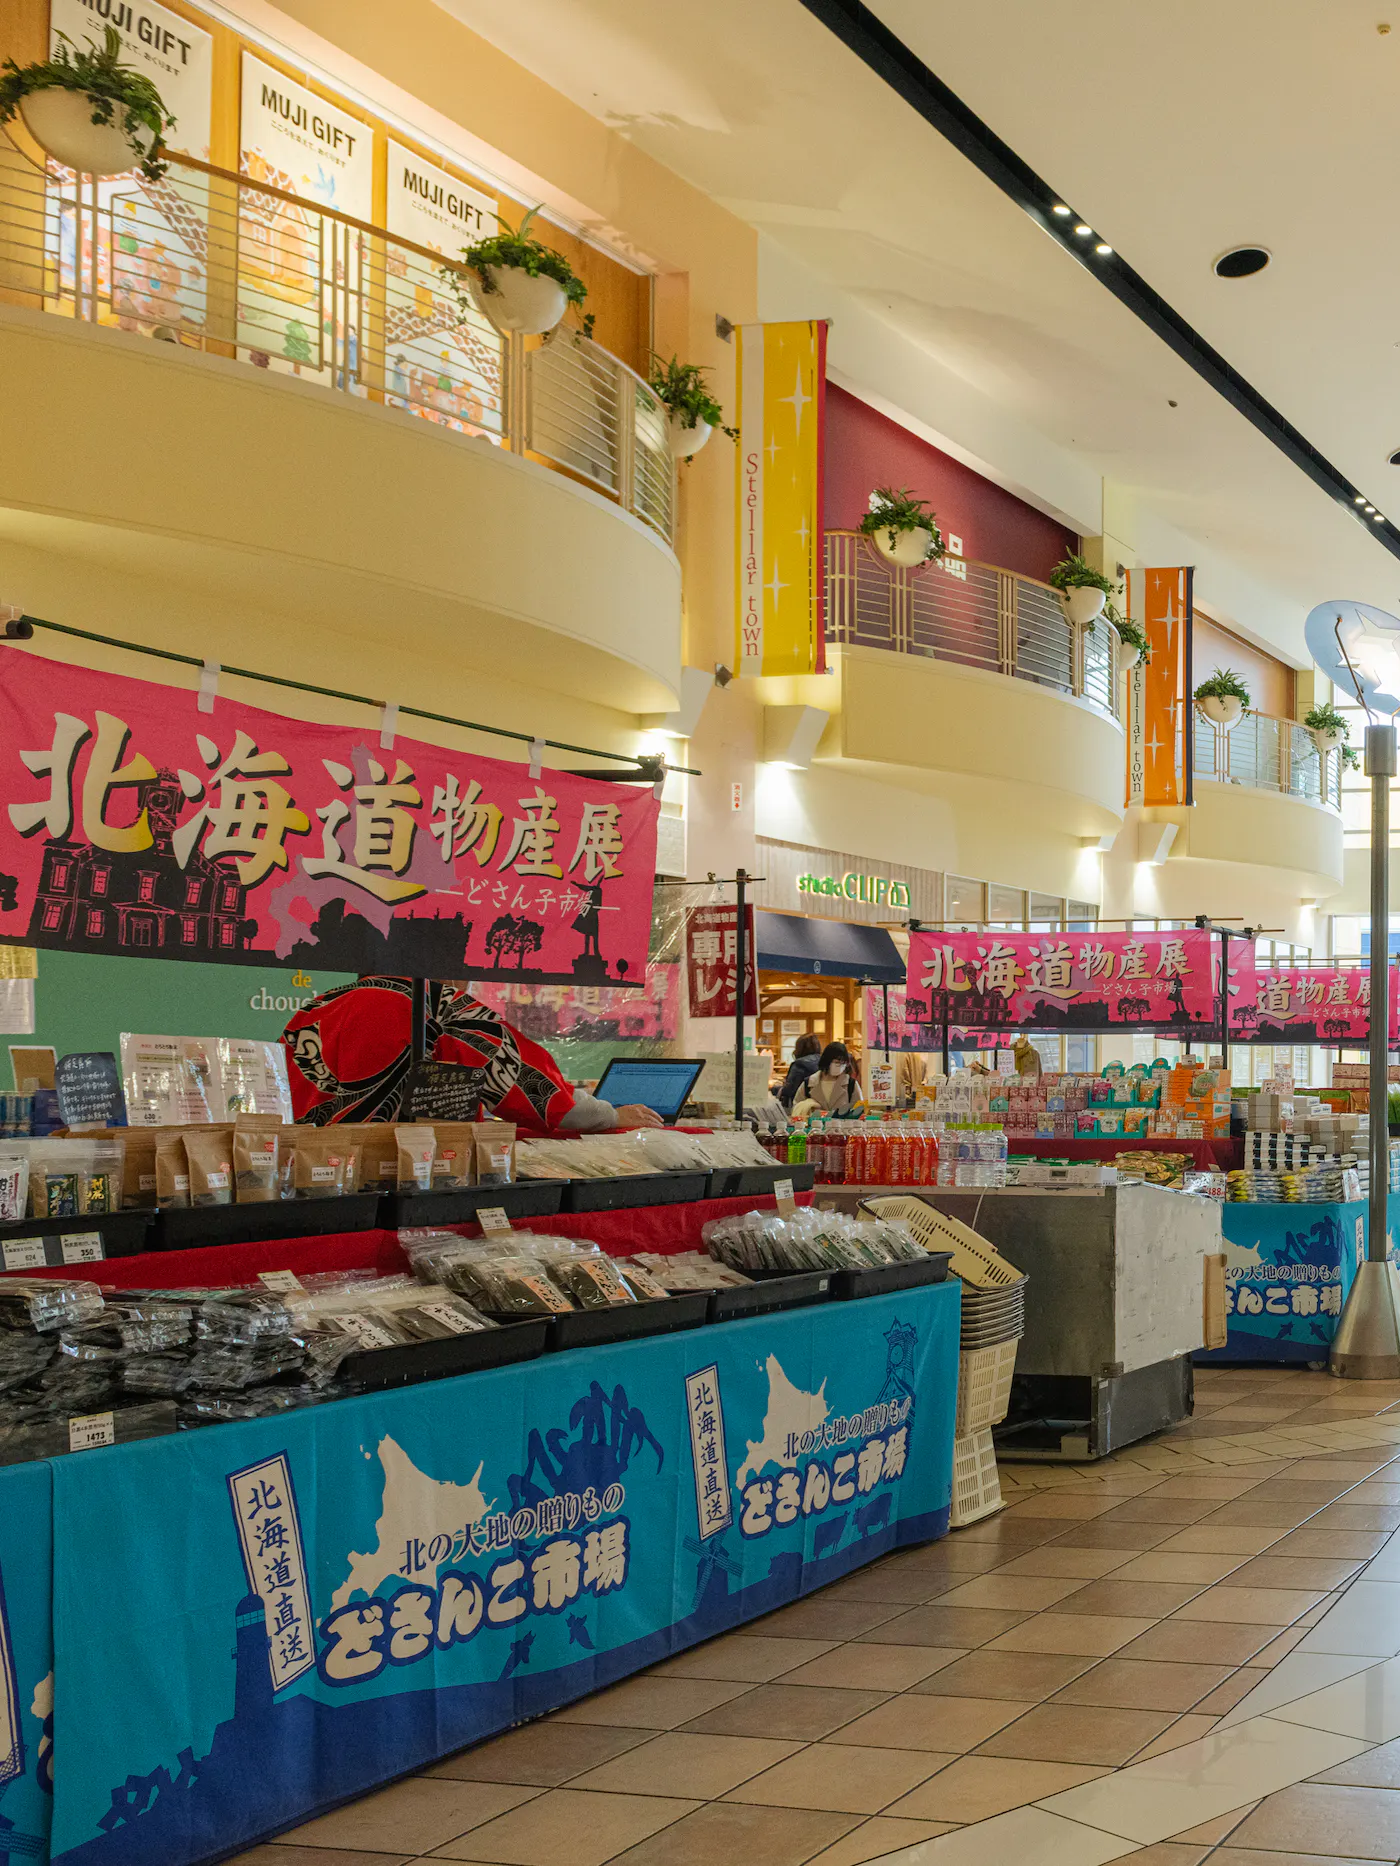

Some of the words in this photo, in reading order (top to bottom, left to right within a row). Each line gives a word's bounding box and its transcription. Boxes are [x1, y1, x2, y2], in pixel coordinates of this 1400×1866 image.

[138, 15, 191, 65] GIFT
[261, 83, 308, 131] MUJI
[312, 115, 357, 157] GIFT
[403, 167, 443, 208] MUJI
[447, 194, 484, 230] GIFT
[746, 453, 759, 585] Stellar
[743, 595, 762, 656] town
[1131, 751, 1144, 792] town
[8, 710, 626, 903] 北海道物産展
[467, 877, 593, 918] どさん子市場
[799, 873, 843, 897] studio
[843, 872, 888, 904] CLIP
[691, 929, 750, 966] 専用
[920, 938, 1194, 1000] 北海道物産展
[250, 987, 318, 1012] chouc
[291, 969, 312, 988] de
[697, 966, 753, 1002] レジ
[80, 1248, 94, 1257] 350
[1225, 1263, 1342, 1283] の大地の贈りもの
[86, 1431, 105, 1442] 1473
[692, 1381, 726, 1526] 北海道直送
[782, 1396, 912, 1460] 北の大地の贈りもの
[741, 1425, 909, 1536] どさんこ市場
[398, 1482, 627, 1576] 北の大地の贈りもの
[246, 1479, 309, 1670] 北海道直送
[323, 1519, 629, 1682] どさんこ市場
